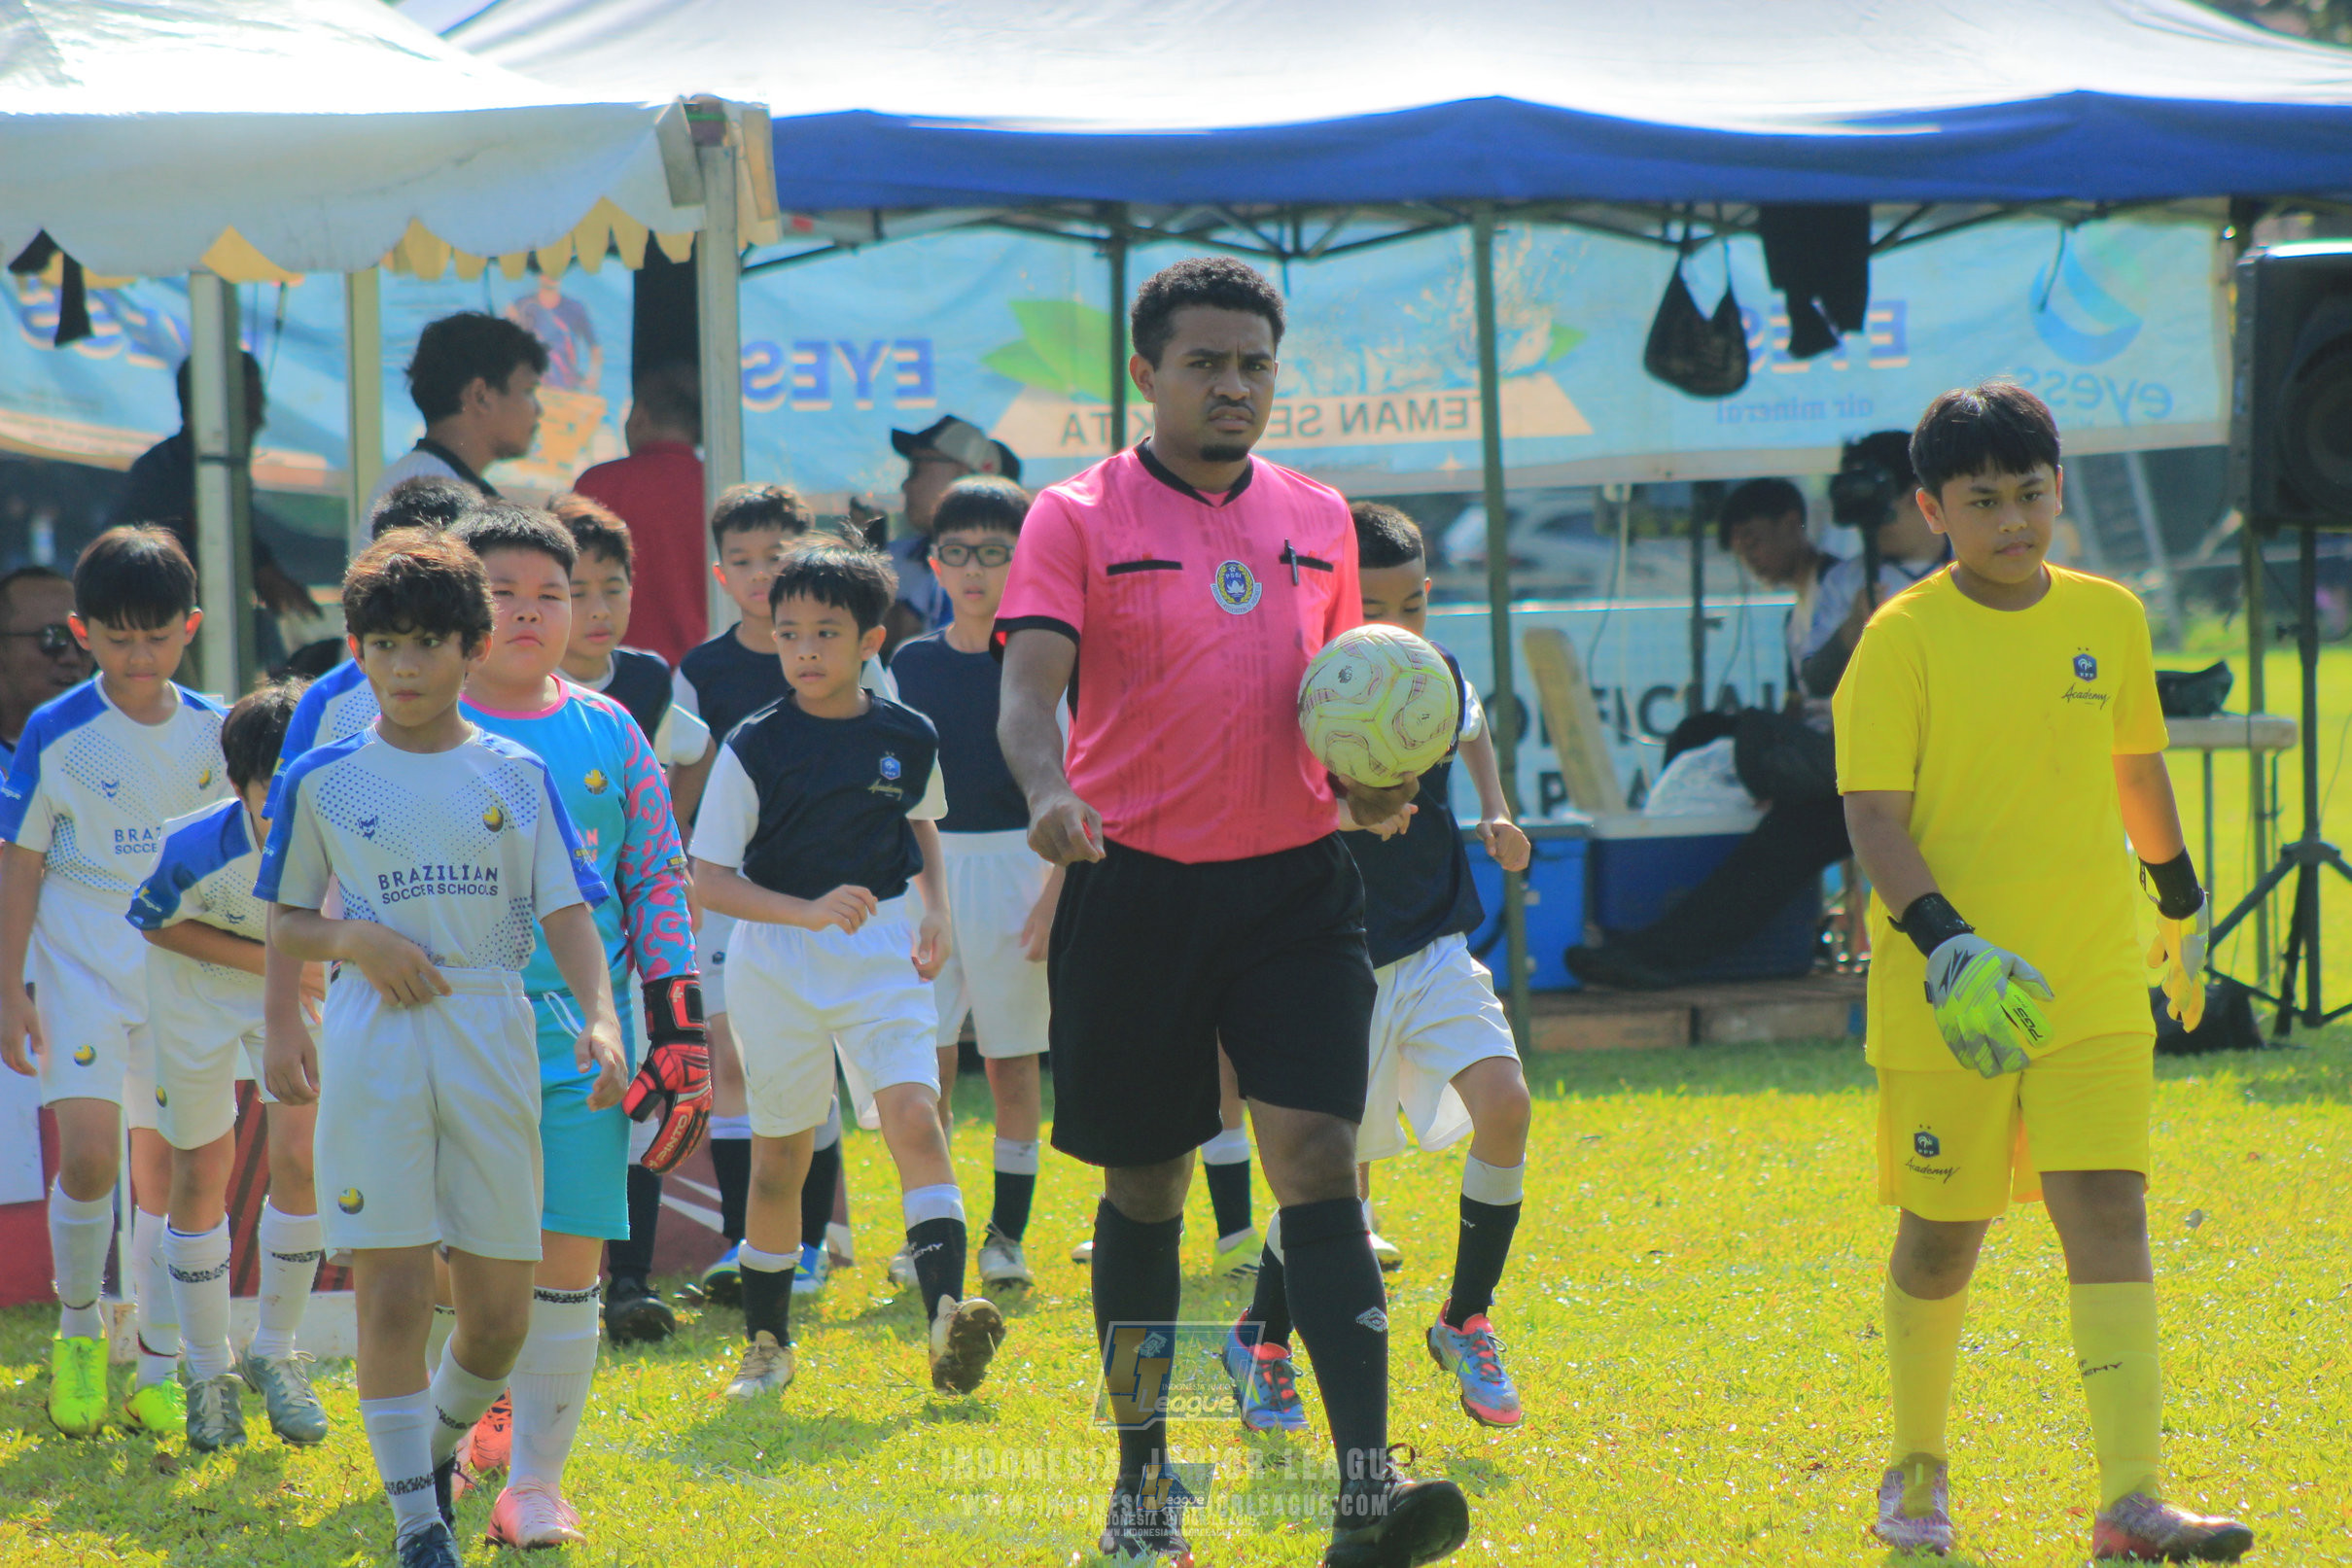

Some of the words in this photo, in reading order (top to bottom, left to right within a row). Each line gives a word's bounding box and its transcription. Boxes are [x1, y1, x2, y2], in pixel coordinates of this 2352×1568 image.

[2060, 682, 2111, 711] Academy
[115, 842, 158, 855] SOCCE
[377, 864, 498, 890] BRAZILIAN
[381, 884, 435, 905] SOCCER
[657, 1114, 689, 1163] PINTO
